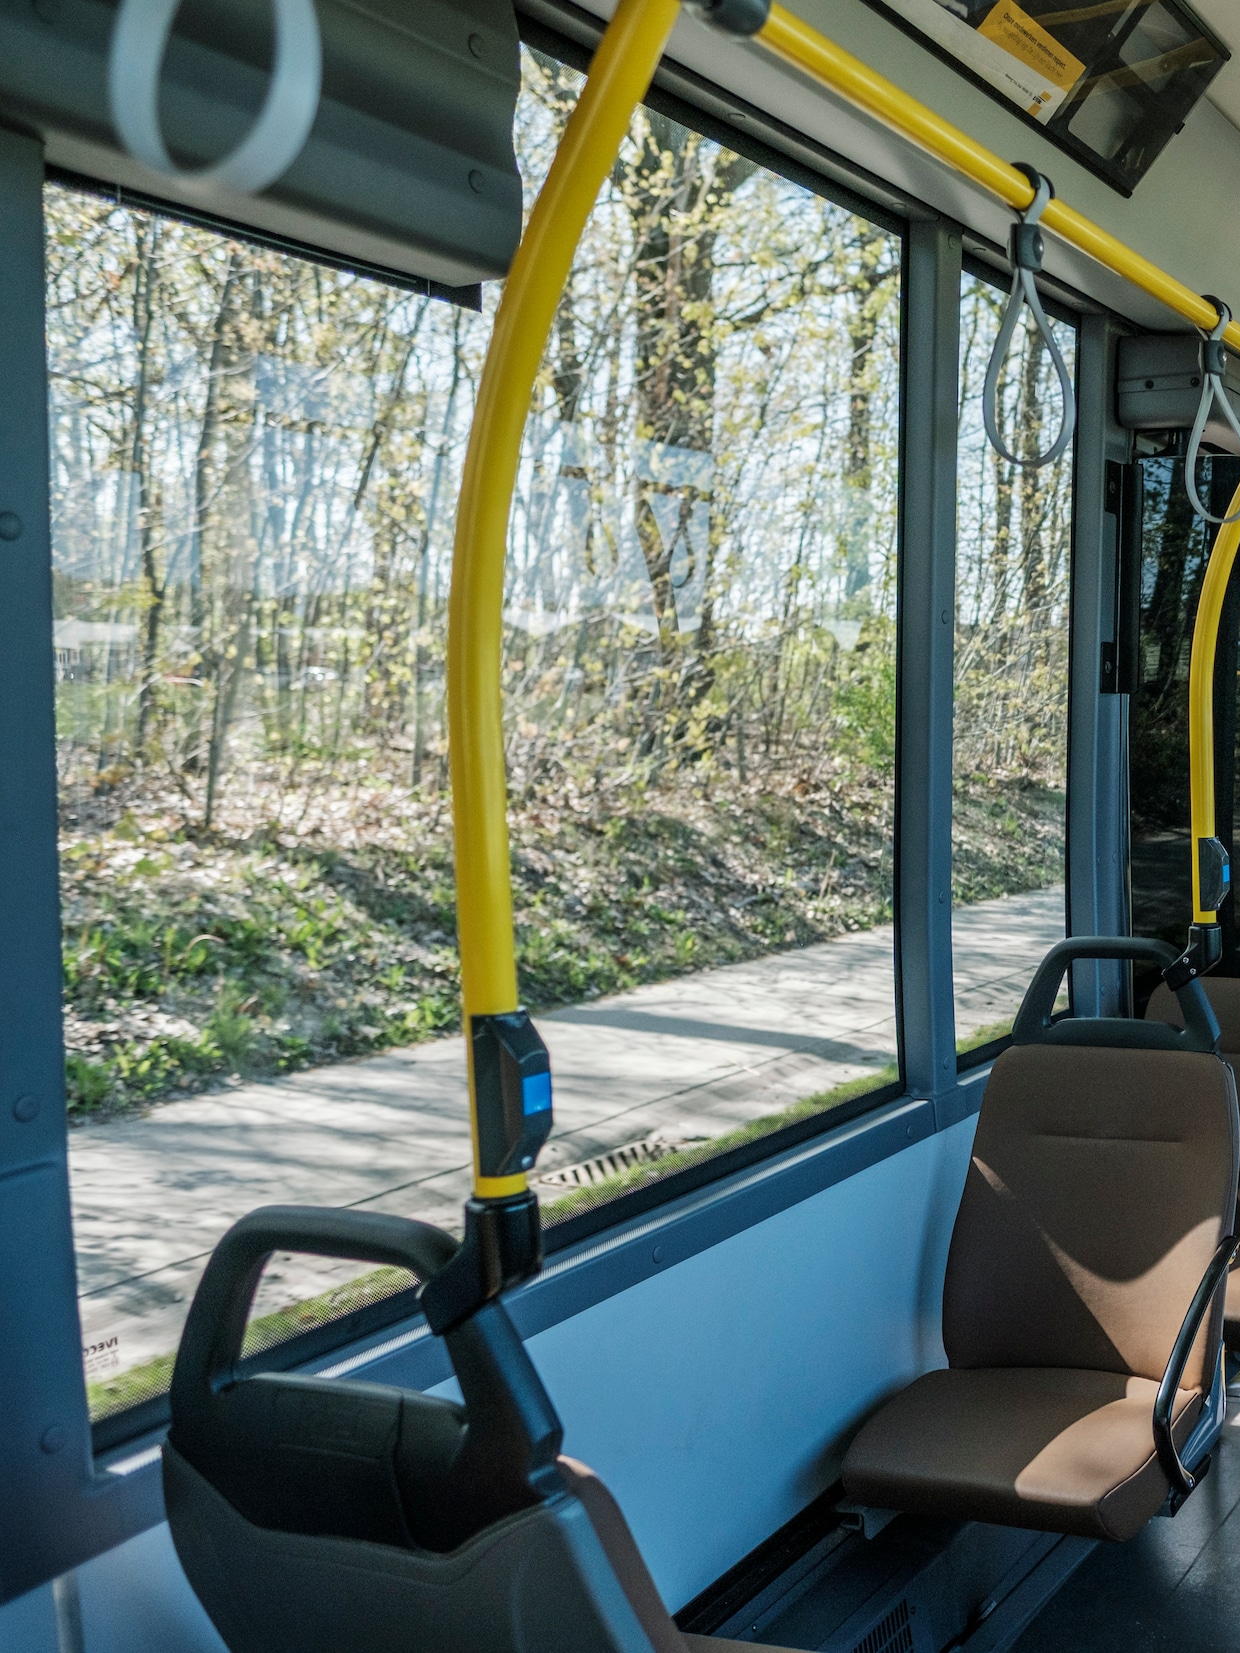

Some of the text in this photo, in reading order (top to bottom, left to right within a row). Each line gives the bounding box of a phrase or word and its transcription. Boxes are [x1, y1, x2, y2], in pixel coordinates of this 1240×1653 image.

[1003, 12, 1014, 24] Onze
[1014, 22, 1037, 44] medewerkers
[1036, 41, 1054, 58] verdienen
